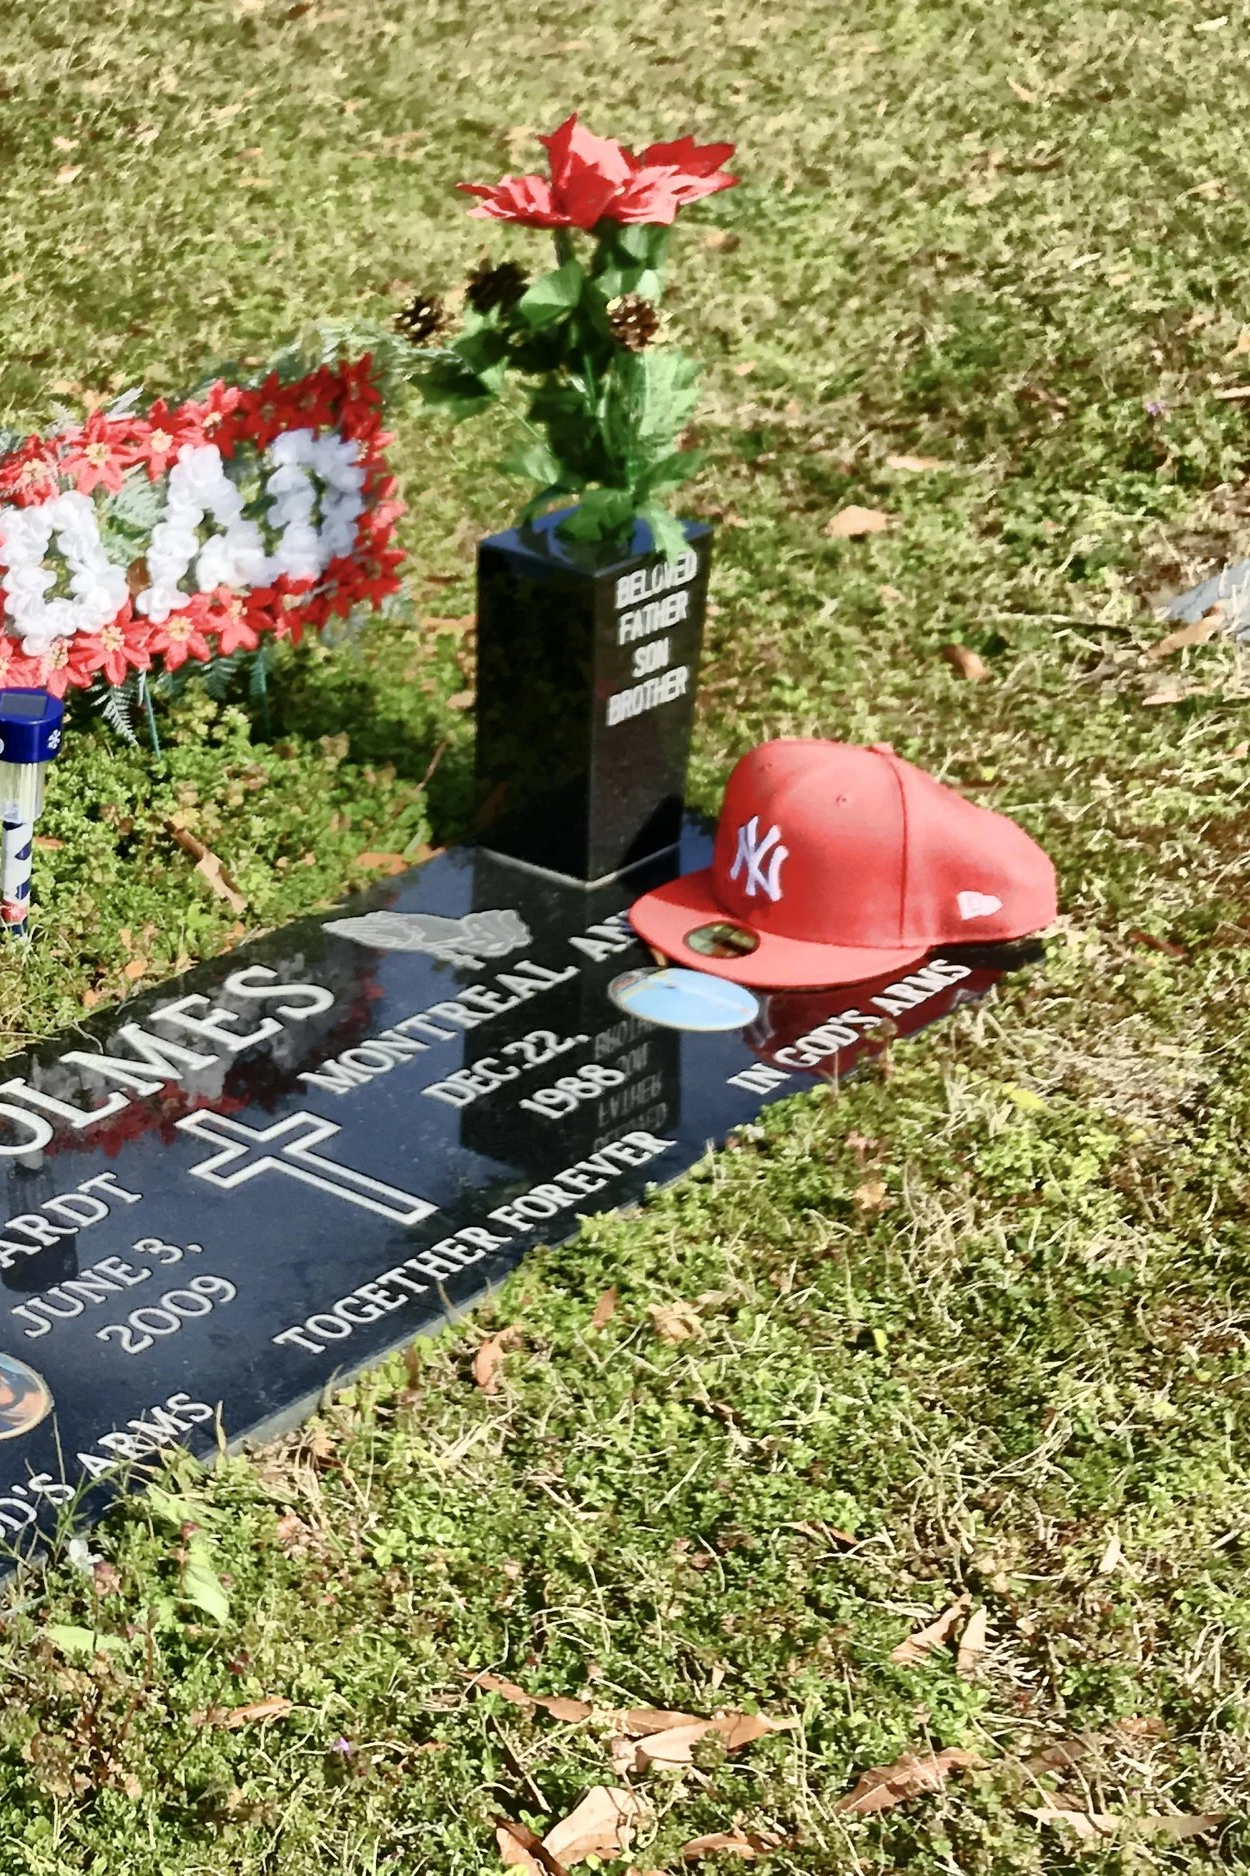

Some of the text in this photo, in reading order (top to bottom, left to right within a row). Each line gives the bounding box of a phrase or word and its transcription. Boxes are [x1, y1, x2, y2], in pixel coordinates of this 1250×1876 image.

[618, 590, 690, 645] FATHER
[632, 637, 670, 677] SON
[606, 666, 690, 726] BROTHER
[730, 815, 790, 902] NY
[297, 960, 581, 1095] MONTREAL
[726, 958, 972, 1096] IN GOD'S ARMS
[519, 1064, 626, 1119] 1988
[272, 1131, 678, 1354] TOGETHER FOREVER
[10, 1254, 152, 1340] JUNE
[96, 1274, 238, 1356] 2009
[76, 1392, 215, 1479] ARMS
